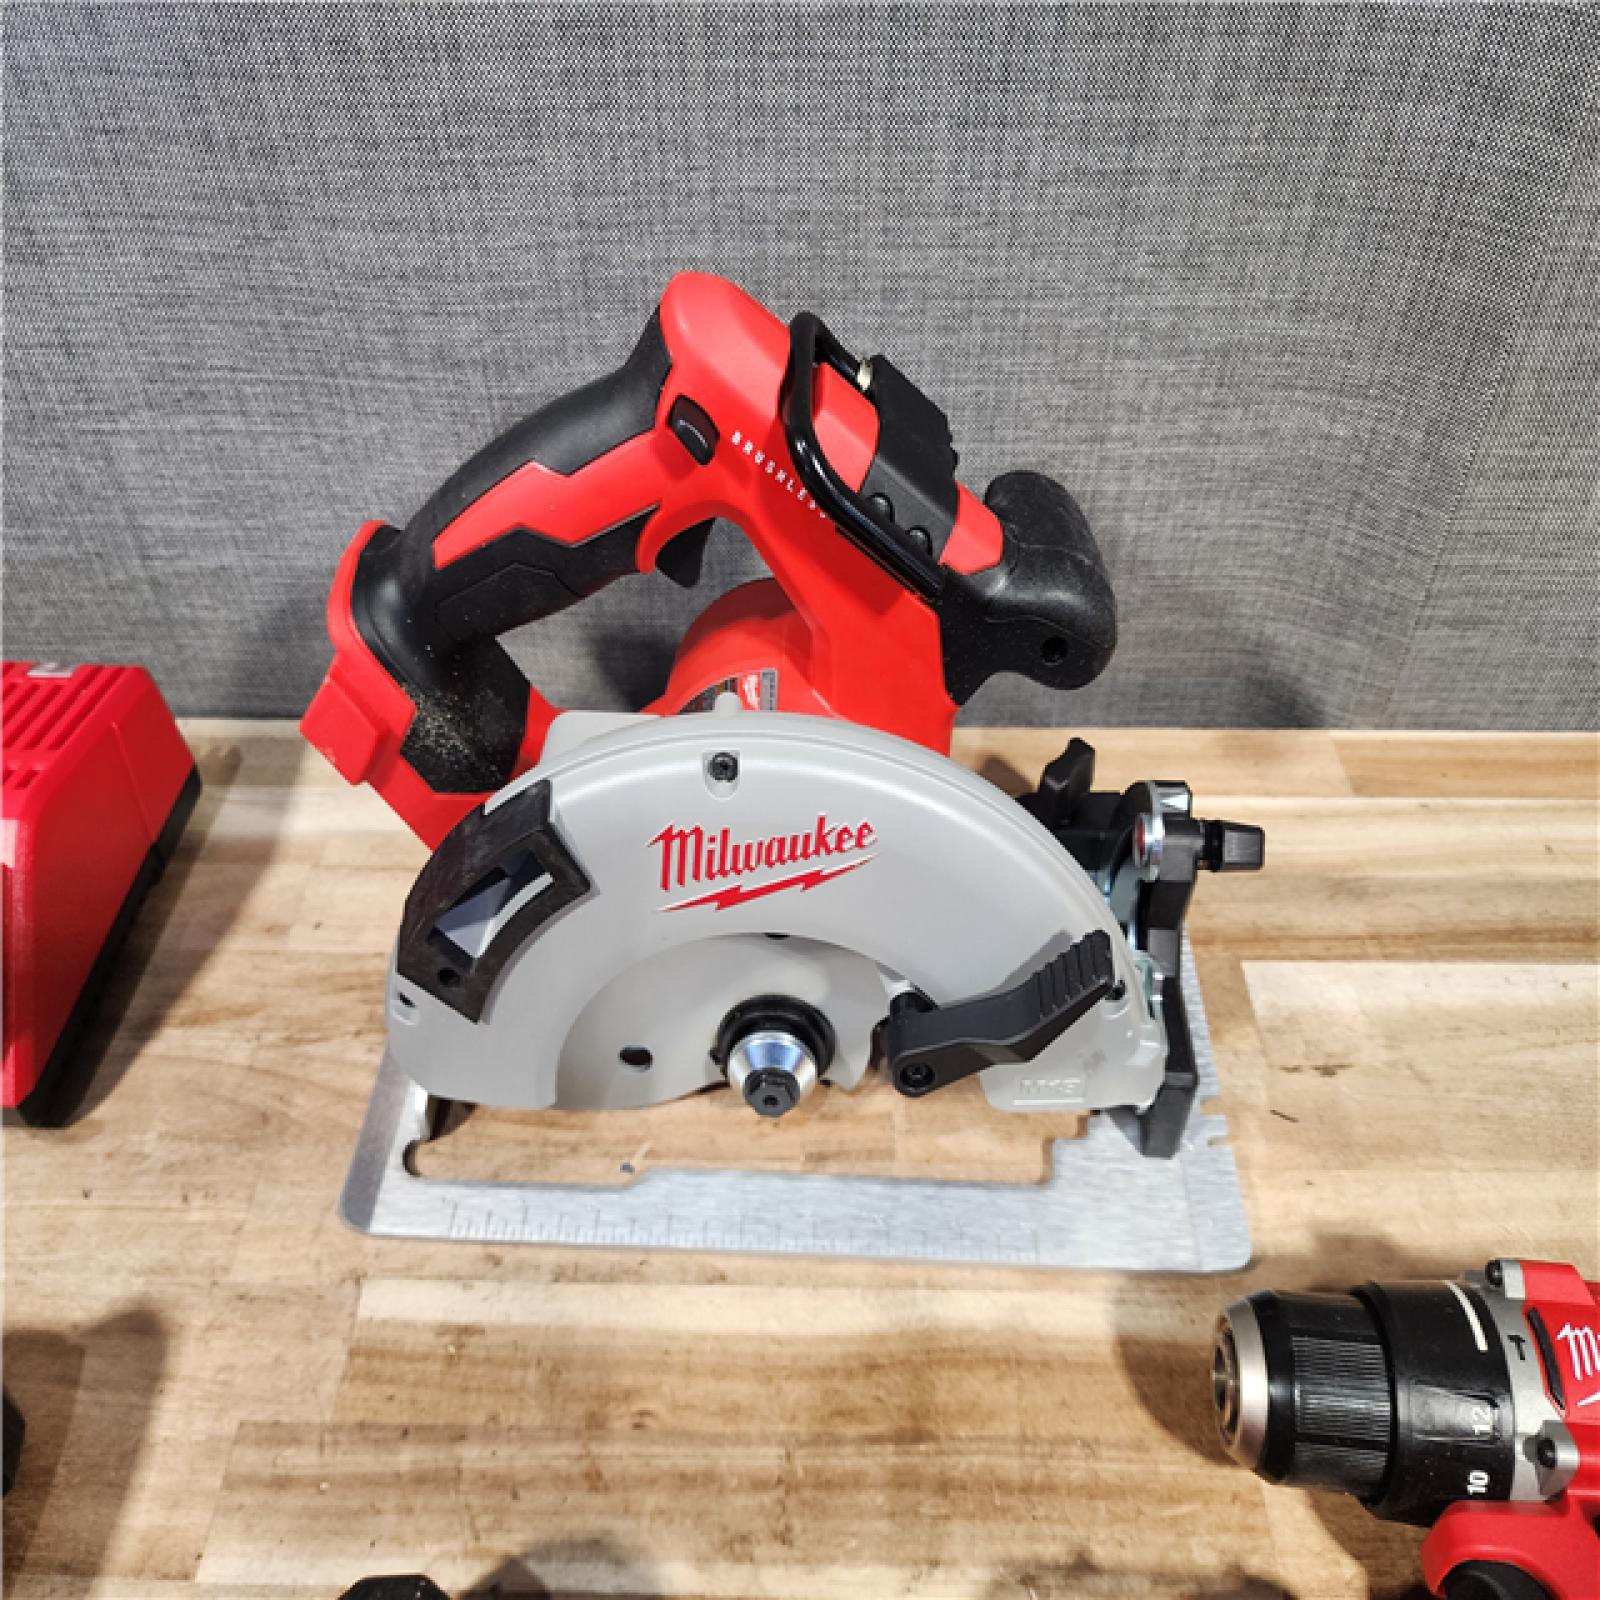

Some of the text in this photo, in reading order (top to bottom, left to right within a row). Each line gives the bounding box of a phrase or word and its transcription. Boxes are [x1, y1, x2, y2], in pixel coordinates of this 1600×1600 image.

[645, 813, 878, 892] Milwaukee
[1473, 1406, 1493, 1436] 12
[1467, 1469, 1490, 1495] 10
